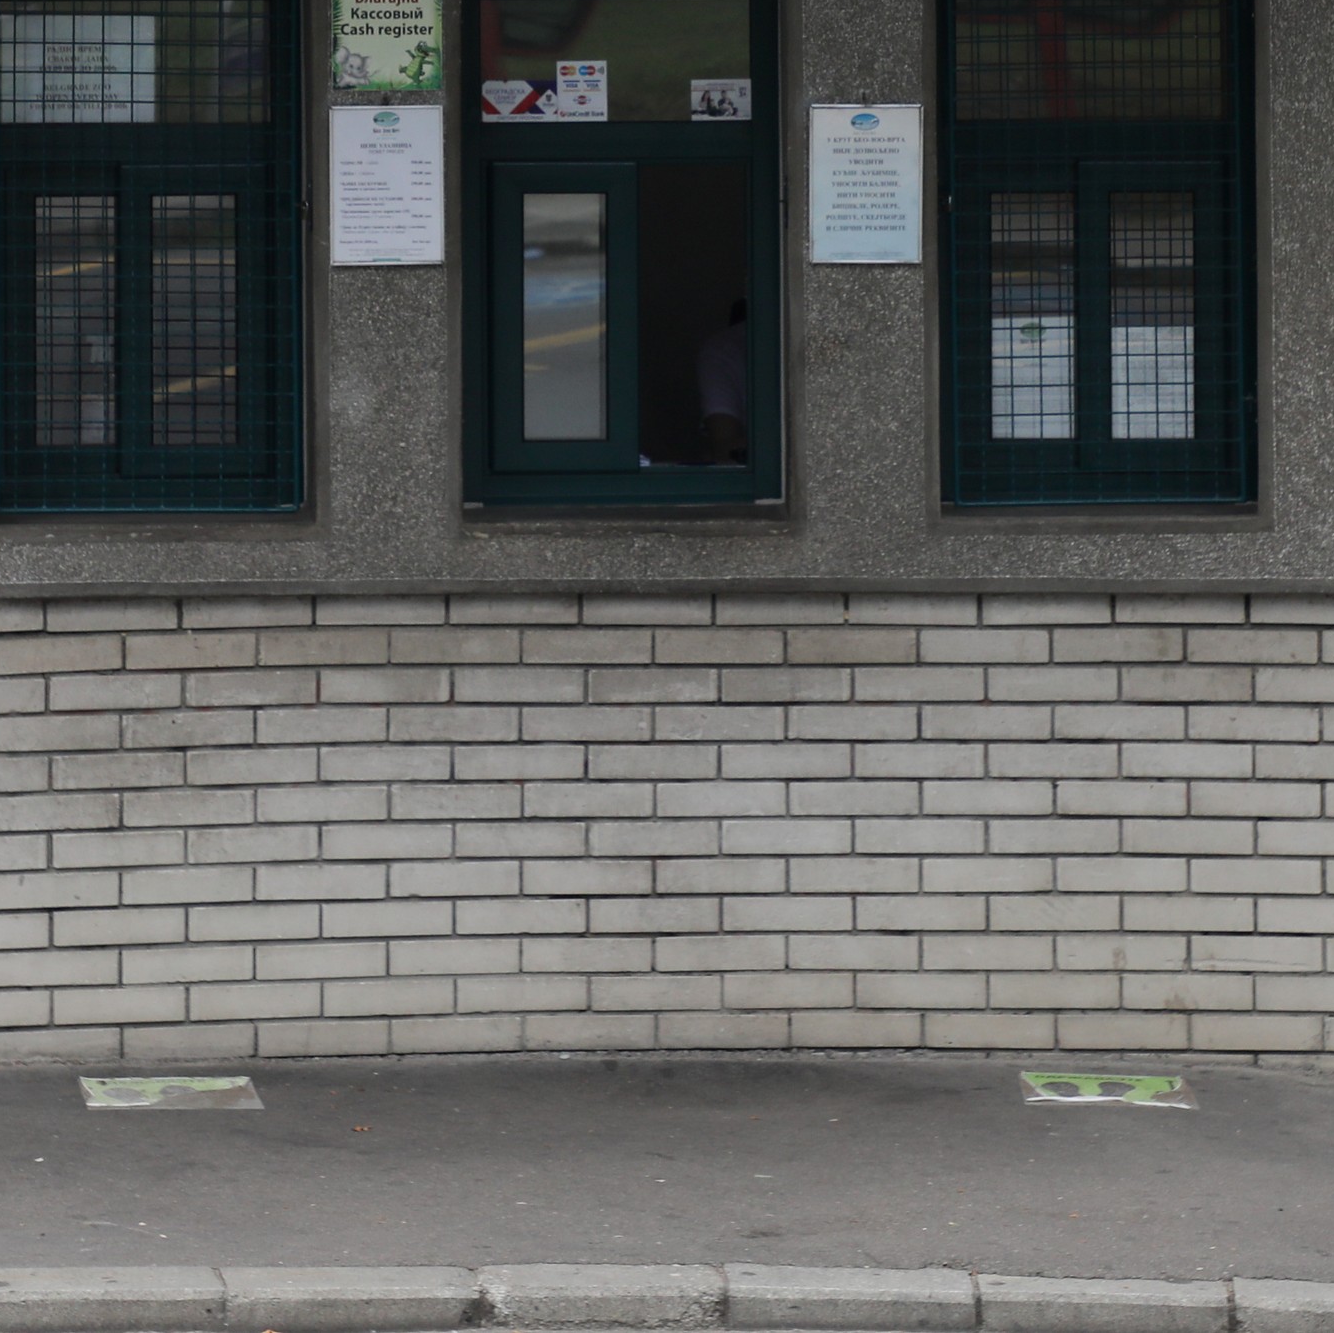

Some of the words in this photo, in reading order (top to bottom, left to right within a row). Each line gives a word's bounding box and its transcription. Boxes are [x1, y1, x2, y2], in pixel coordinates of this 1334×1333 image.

[351, 7, 423, 19] Кассовый
[341, 23, 374, 35] Cash
[378, 23, 434, 38] register
